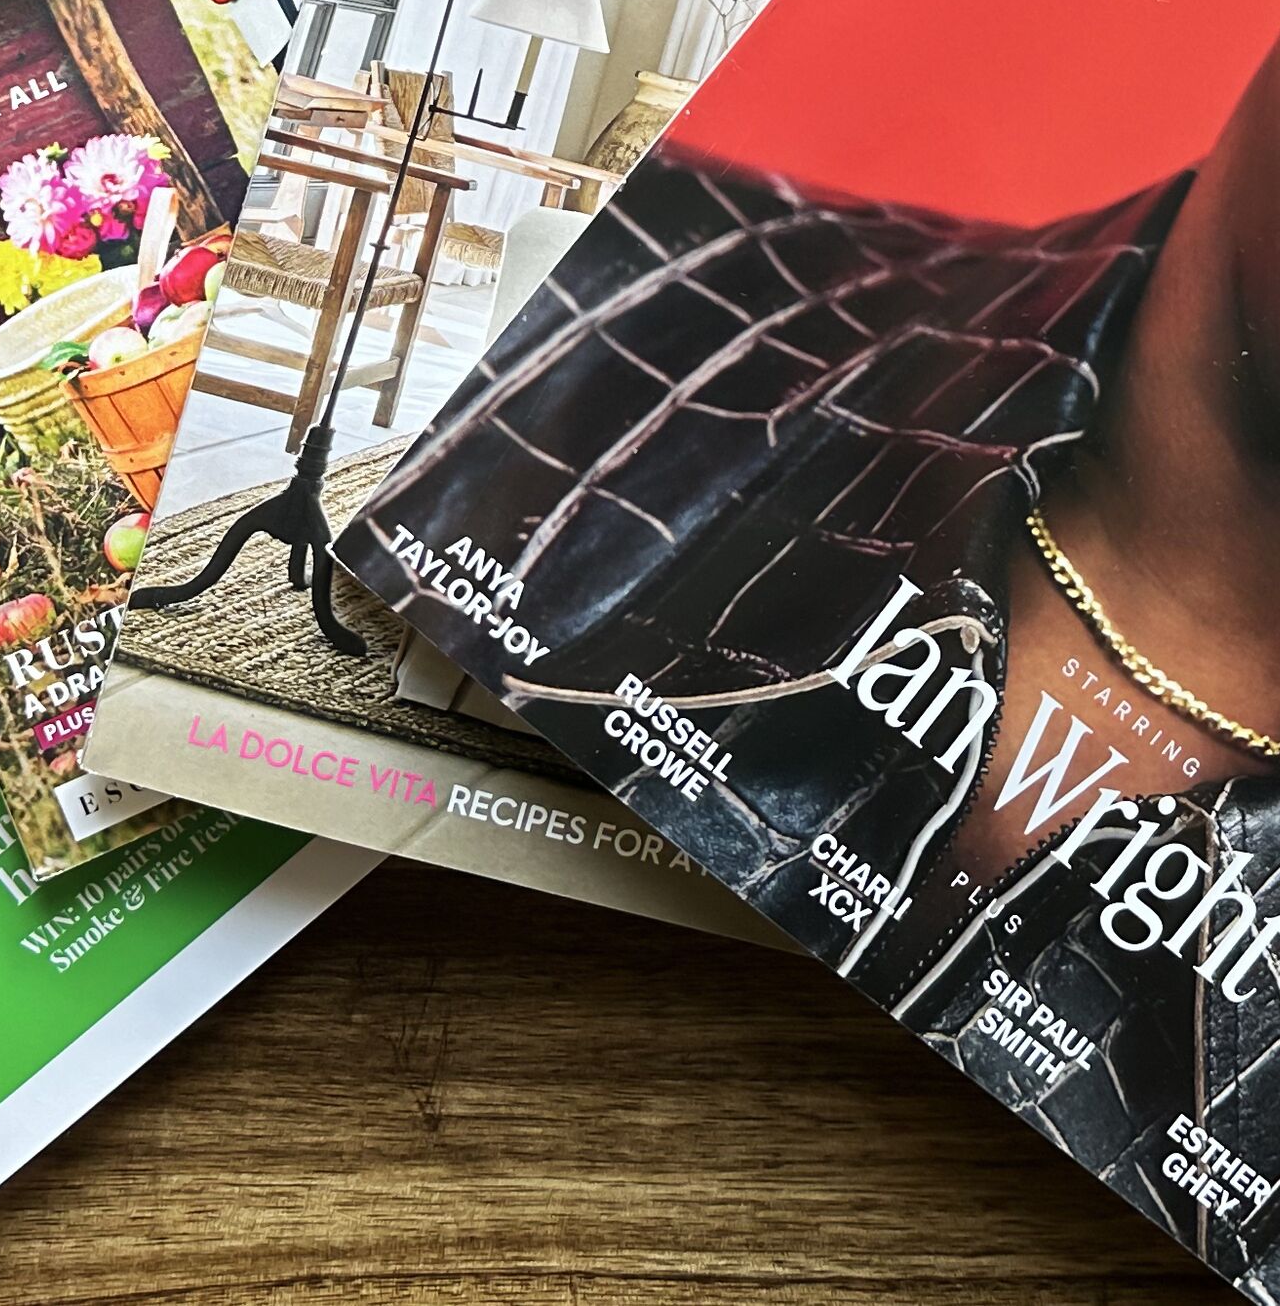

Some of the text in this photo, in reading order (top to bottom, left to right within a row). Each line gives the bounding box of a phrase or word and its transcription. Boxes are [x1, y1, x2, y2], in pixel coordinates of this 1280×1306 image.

[9, 70, 69, 112] ALL
[387, 524, 552, 668] TAYLOR-JOY
[445, 535, 526, 610] ANYA
[23, 693, 47, 720] A
[830, 573, 998, 774] Ian
[1061, 656, 1201, 779] STARRING
[43, 705, 96, 742] PLUS
[603, 710, 711, 802] CROWE
[615, 673, 733, 782] RUSSELL
[188, 715, 231, 755] LA
[238, 728, 359, 788] DOLCE
[369, 762, 438, 809] VITA
[446, 783, 589, 846] RECIPES
[591, 820, 667, 866] FOR
[20, 904, 76, 955] WIN:
[74, 881, 105, 913] 10
[103, 837, 163, 896] pairs
[49, 904, 125, 974] Smoke
[121, 882, 146, 911] &
[143, 848, 194, 893] Fire
[808, 873, 875, 933] XCX
[811, 832, 914, 921] CHARLI
[949, 869, 1024, 935] PLUS
[976, 1007, 1067, 1084] SMITH
[982, 969, 1098, 1070] SIR PAUL
[1160, 1151, 1240, 1221] GHEY
[1165, 1114, 1272, 1205] ESTHER
